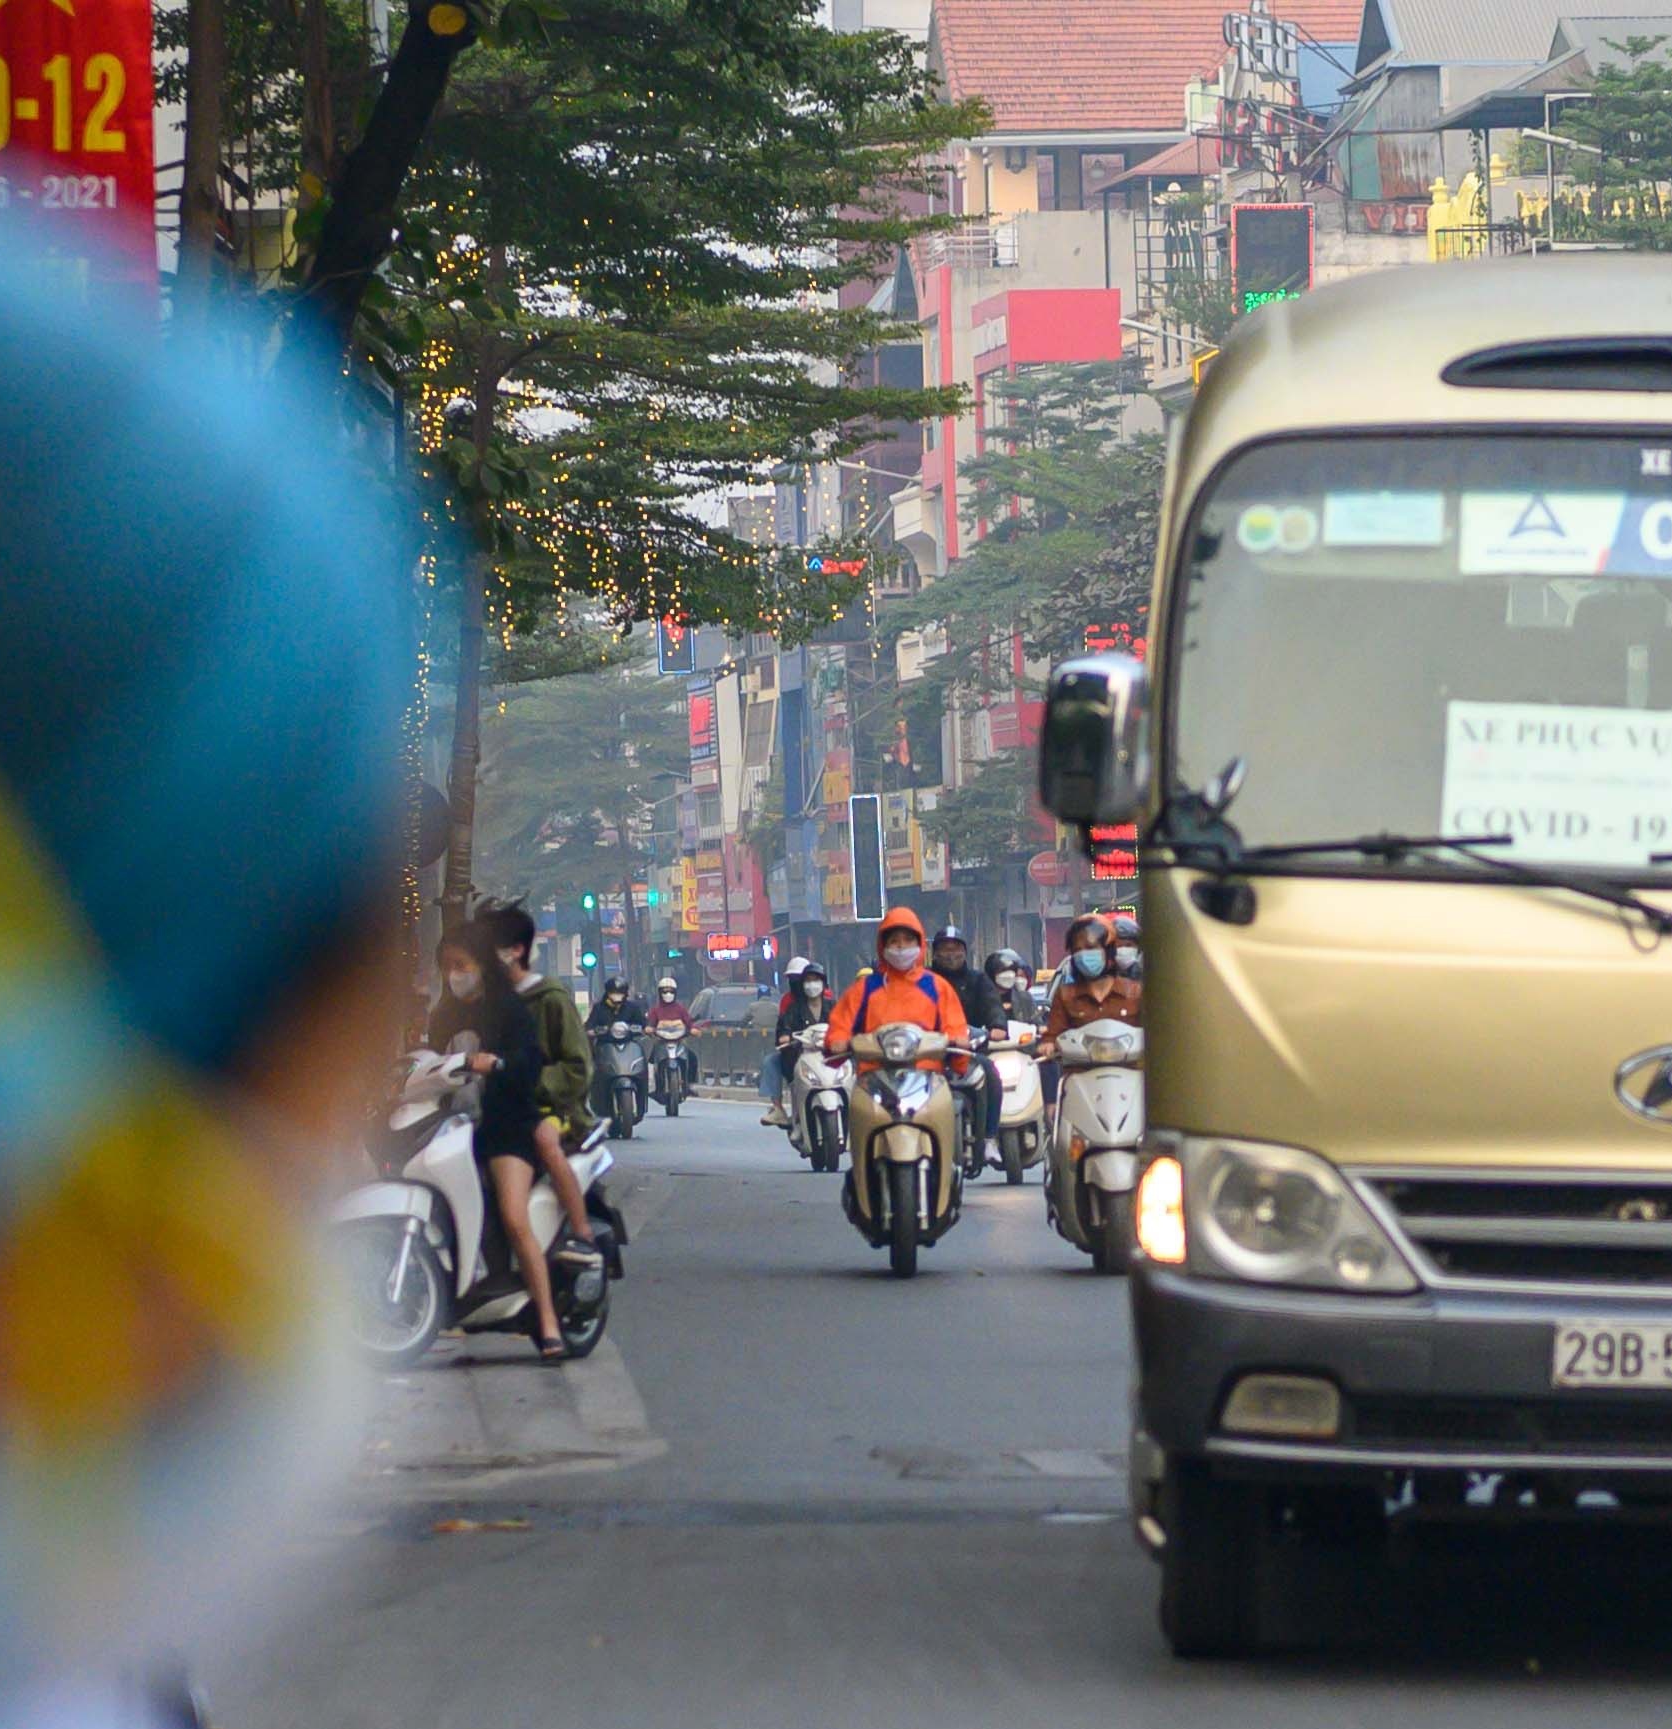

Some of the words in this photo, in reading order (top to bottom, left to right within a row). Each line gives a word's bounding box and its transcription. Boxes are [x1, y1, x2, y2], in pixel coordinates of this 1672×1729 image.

[42, 174, 118, 209] 2021
[1640, 447, 1672, 476] XE
[1461, 719, 1503, 743] XE
[1516, 721, 1614, 753] PHỤC
[1453, 807, 1589, 838] COVID
[1632, 814, 1668, 843] 19
